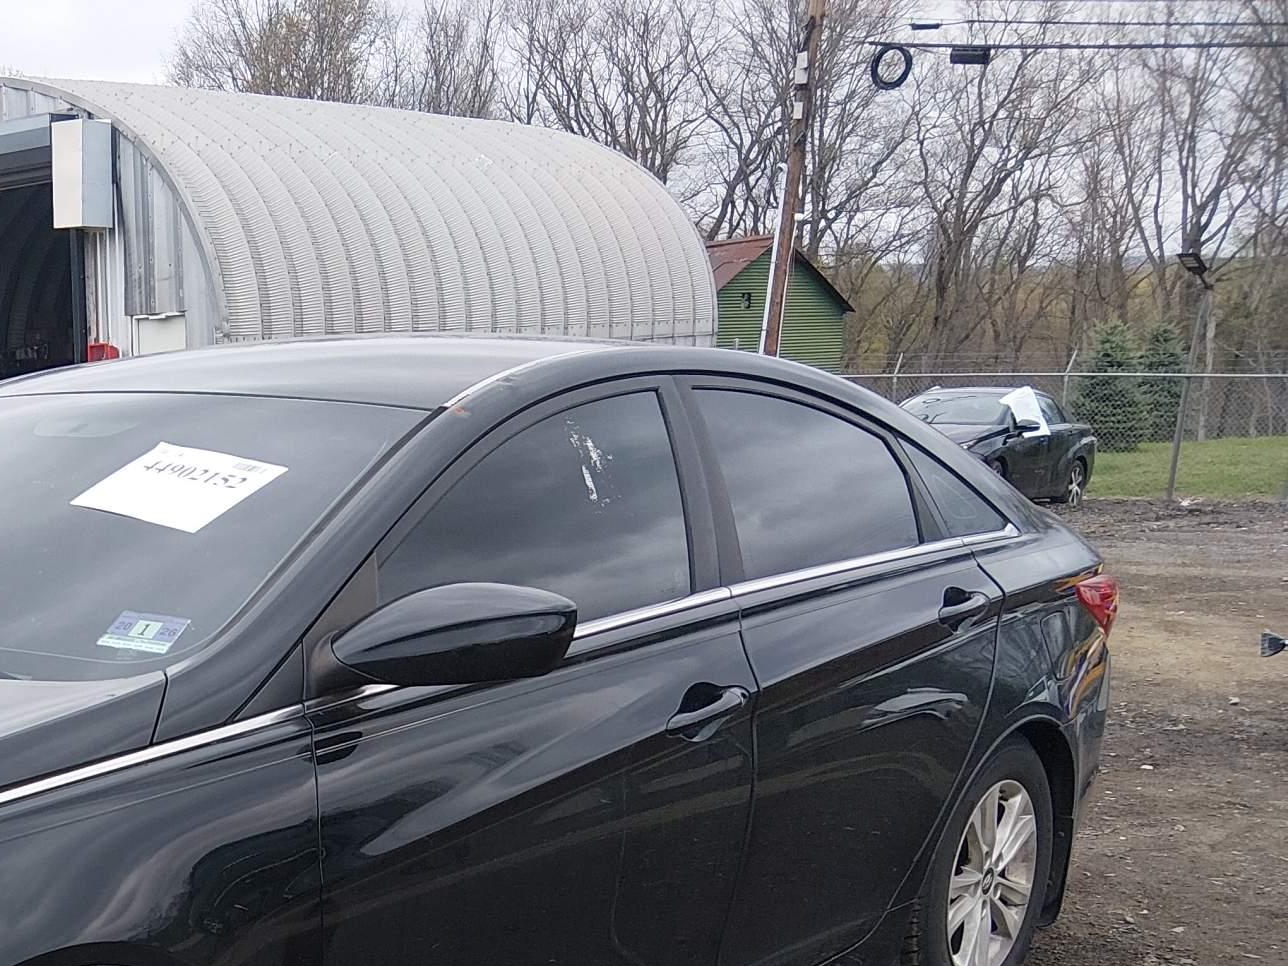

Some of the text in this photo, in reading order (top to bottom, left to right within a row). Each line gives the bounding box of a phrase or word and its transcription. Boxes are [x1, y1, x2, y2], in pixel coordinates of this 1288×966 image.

[144, 460, 248, 489] 44902152
[114, 621, 179, 637] 20 1 26
